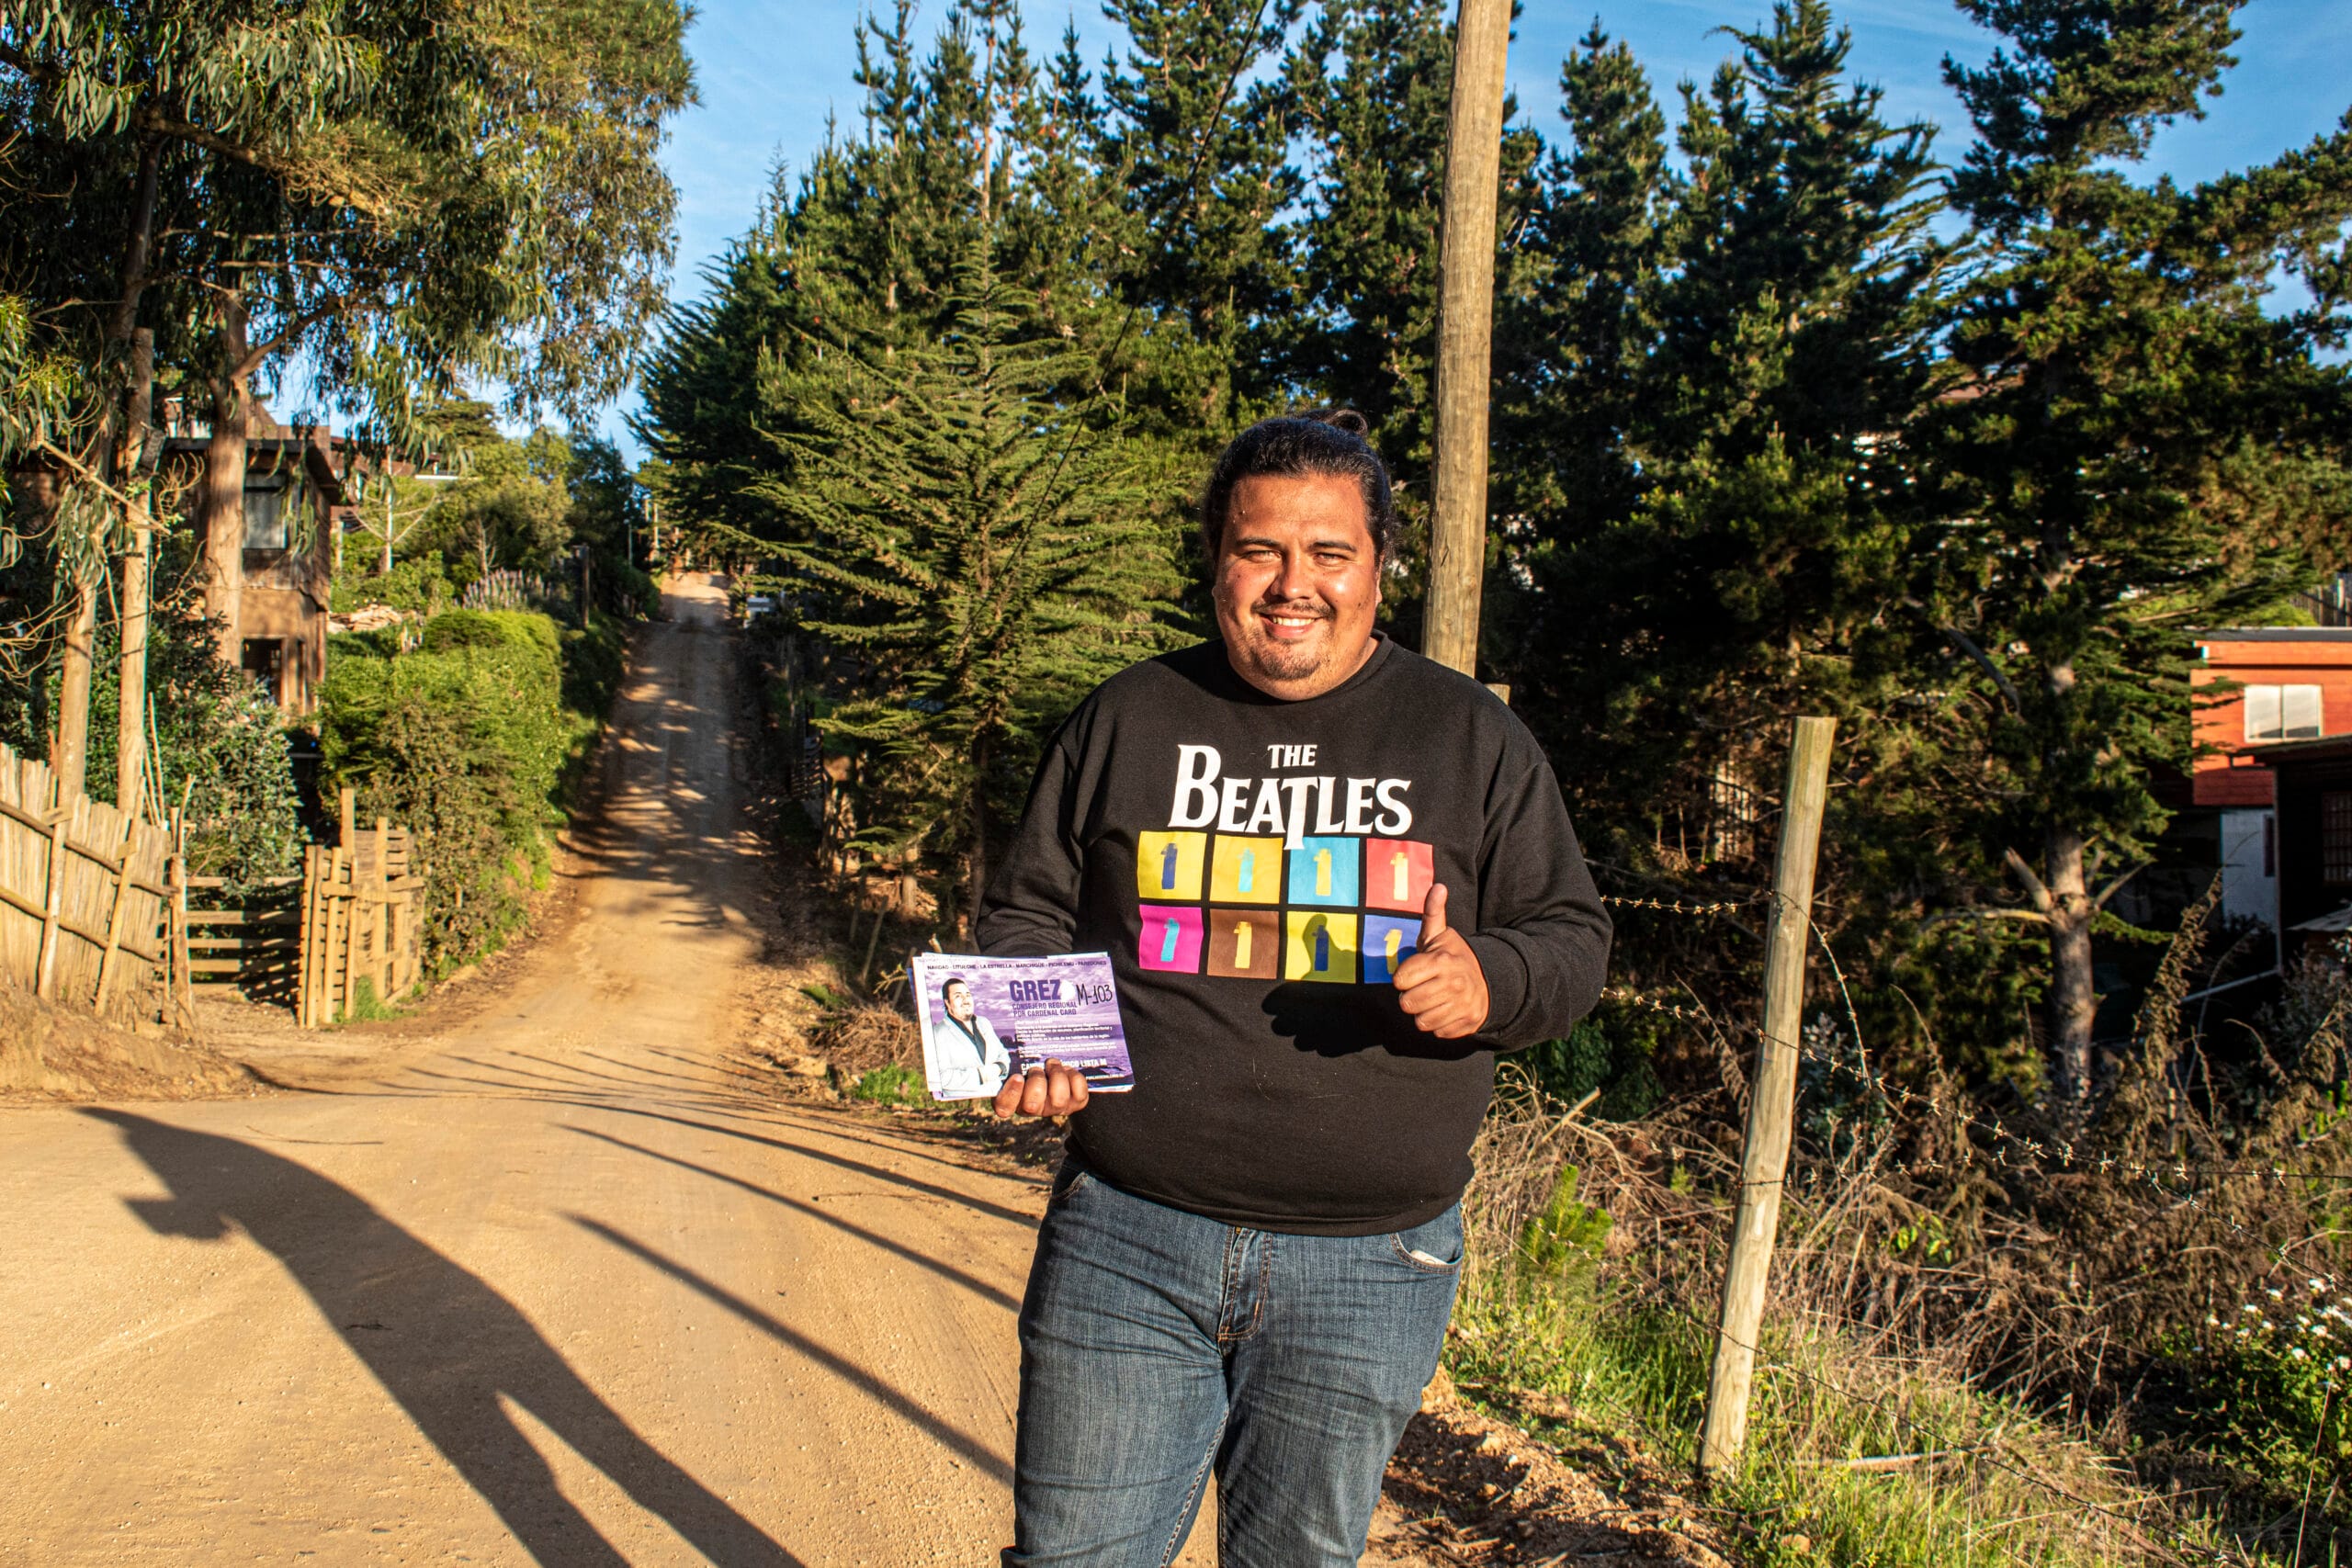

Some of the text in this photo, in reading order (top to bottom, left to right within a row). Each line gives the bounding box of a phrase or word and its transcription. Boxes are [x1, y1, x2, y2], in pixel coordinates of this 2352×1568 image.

[1267, 743, 1317, 769] THE
[1167, 743, 1413, 850] BEATLES
[1160, 842, 1408, 901] 1 1 1 1
[1160, 918, 1403, 975] 1 1 1 1
[1009, 979, 1061, 1002] GREZ
[1076, 984, 1113, 1006] M-103
[1027, 1009, 1059, 1017] CARDENAL
